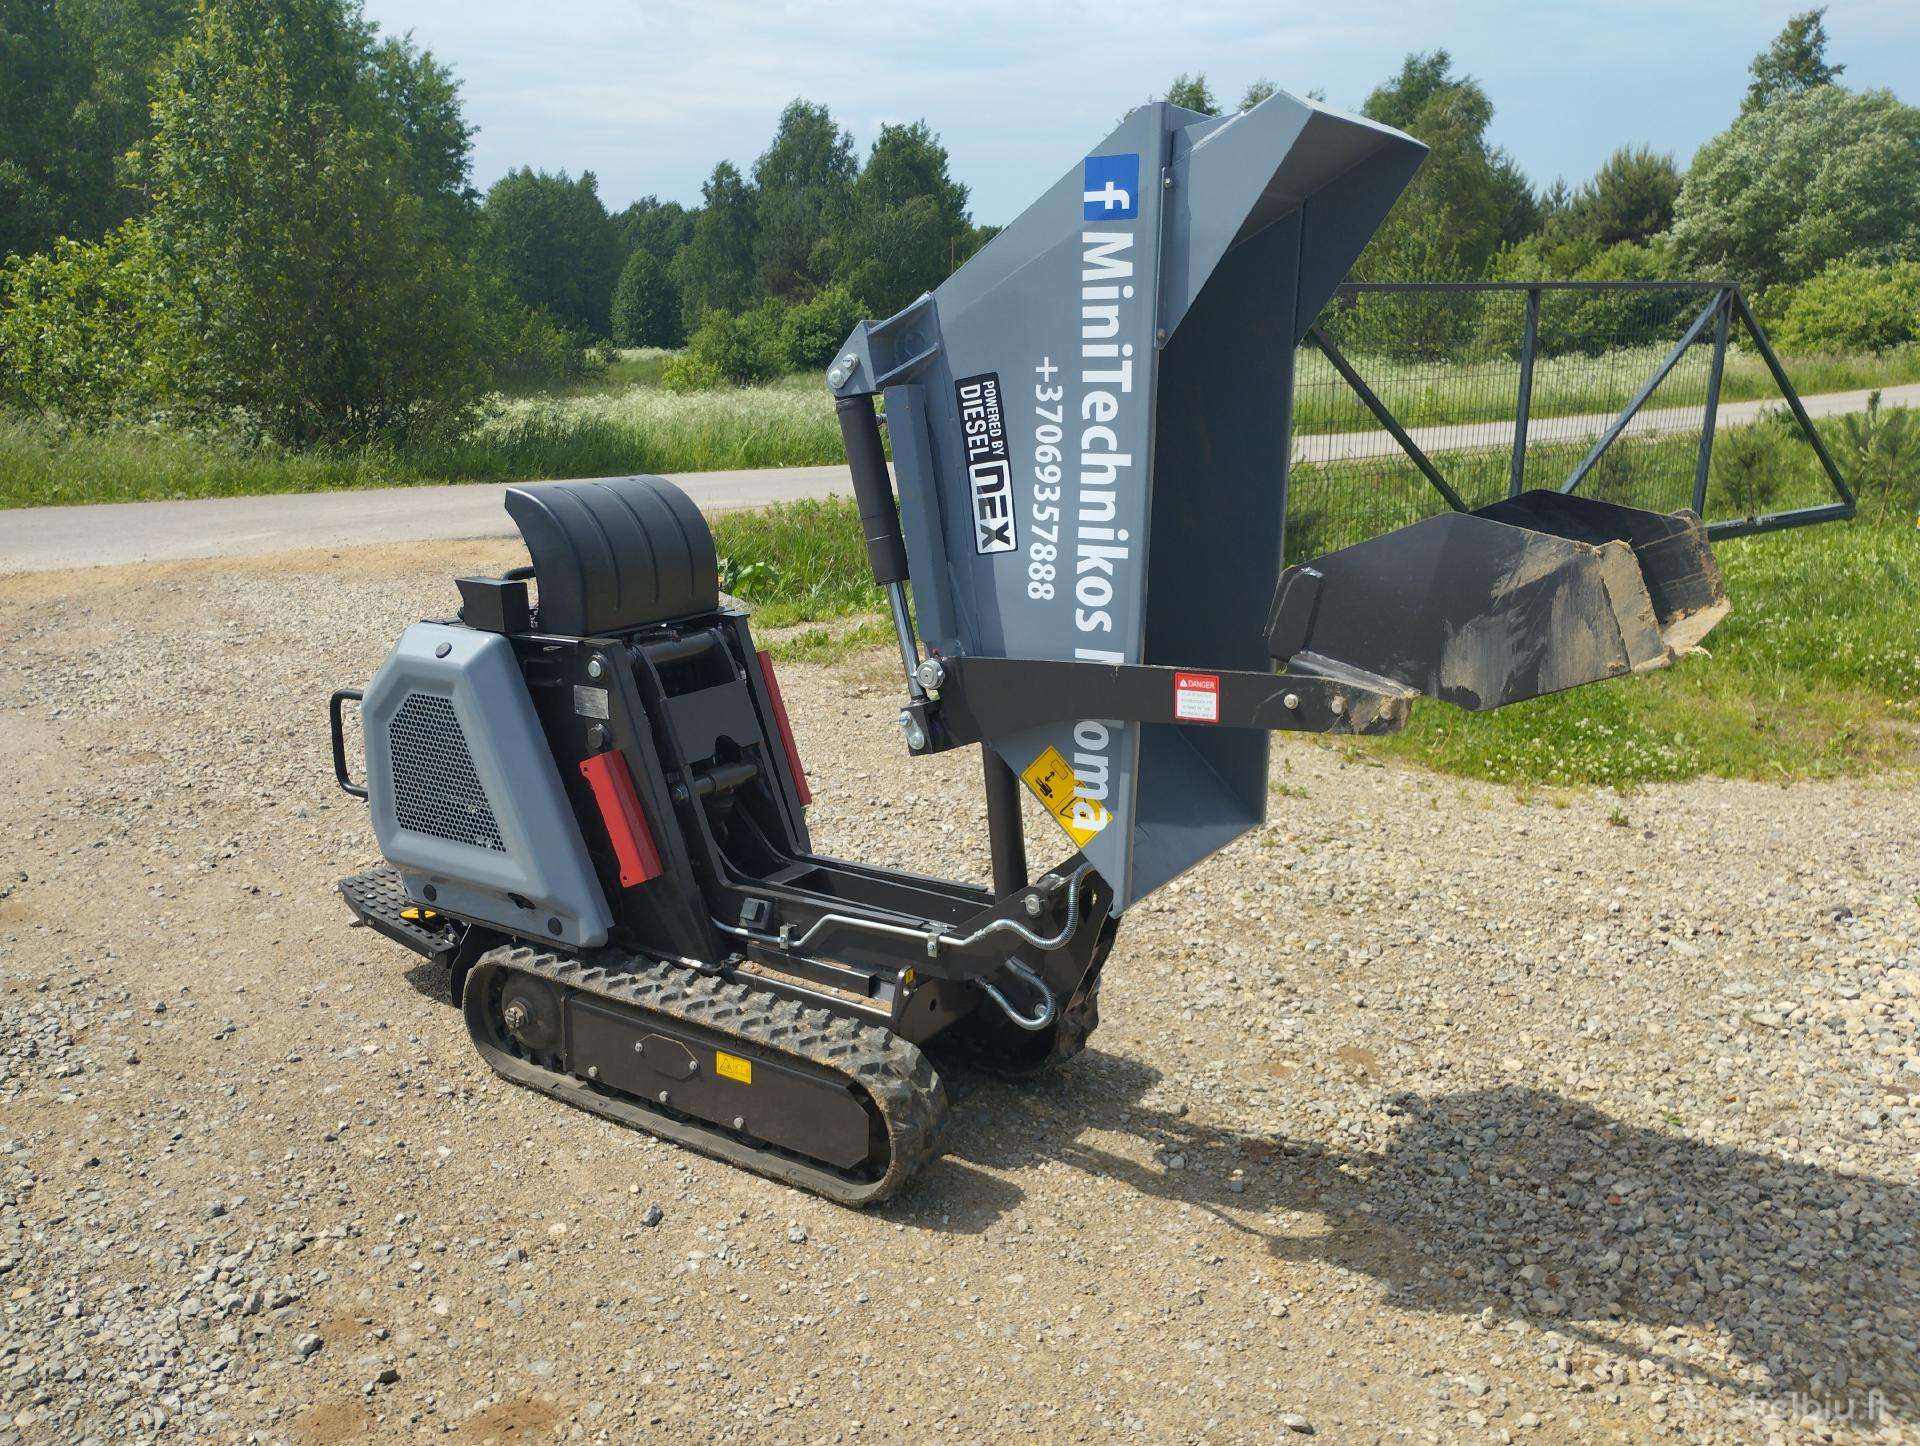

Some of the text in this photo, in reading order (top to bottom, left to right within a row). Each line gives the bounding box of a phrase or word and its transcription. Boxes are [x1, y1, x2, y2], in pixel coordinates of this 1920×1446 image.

[960, 383, 990, 462] DIESEL
[982, 380, 1005, 456] POWERED BY
[1074, 232, 1134, 633] MiniTechnikos
[1027, 356, 1064, 600] +37069357888
[1187, 679, 1216, 690] DANGER
